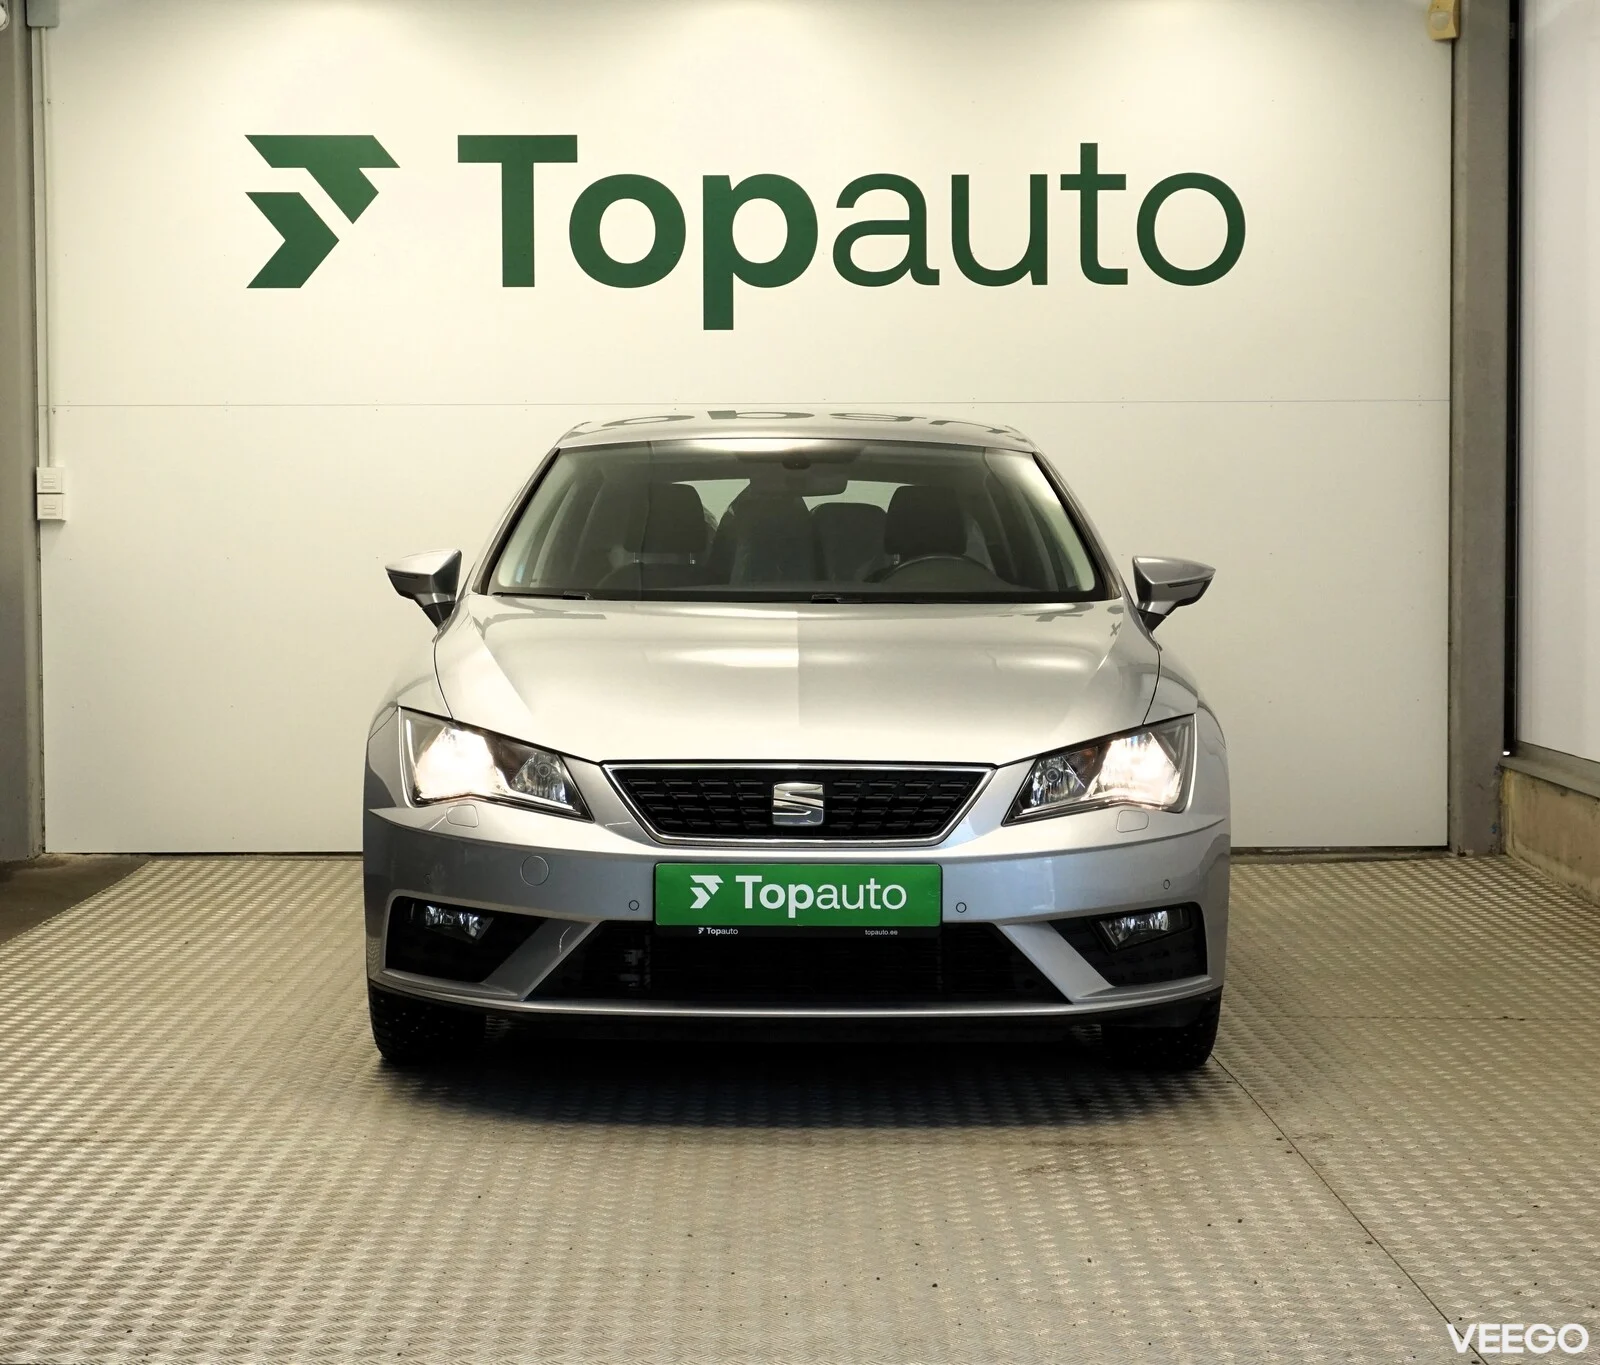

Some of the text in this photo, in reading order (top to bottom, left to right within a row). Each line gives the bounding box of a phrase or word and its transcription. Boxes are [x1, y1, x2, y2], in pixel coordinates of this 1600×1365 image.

[458, 135, 1246, 330] Topauto
[735, 875, 907, 918] Topauto
[706, 927, 738, 936] Topauto
[865, 929, 898, 937] topauto.ee
